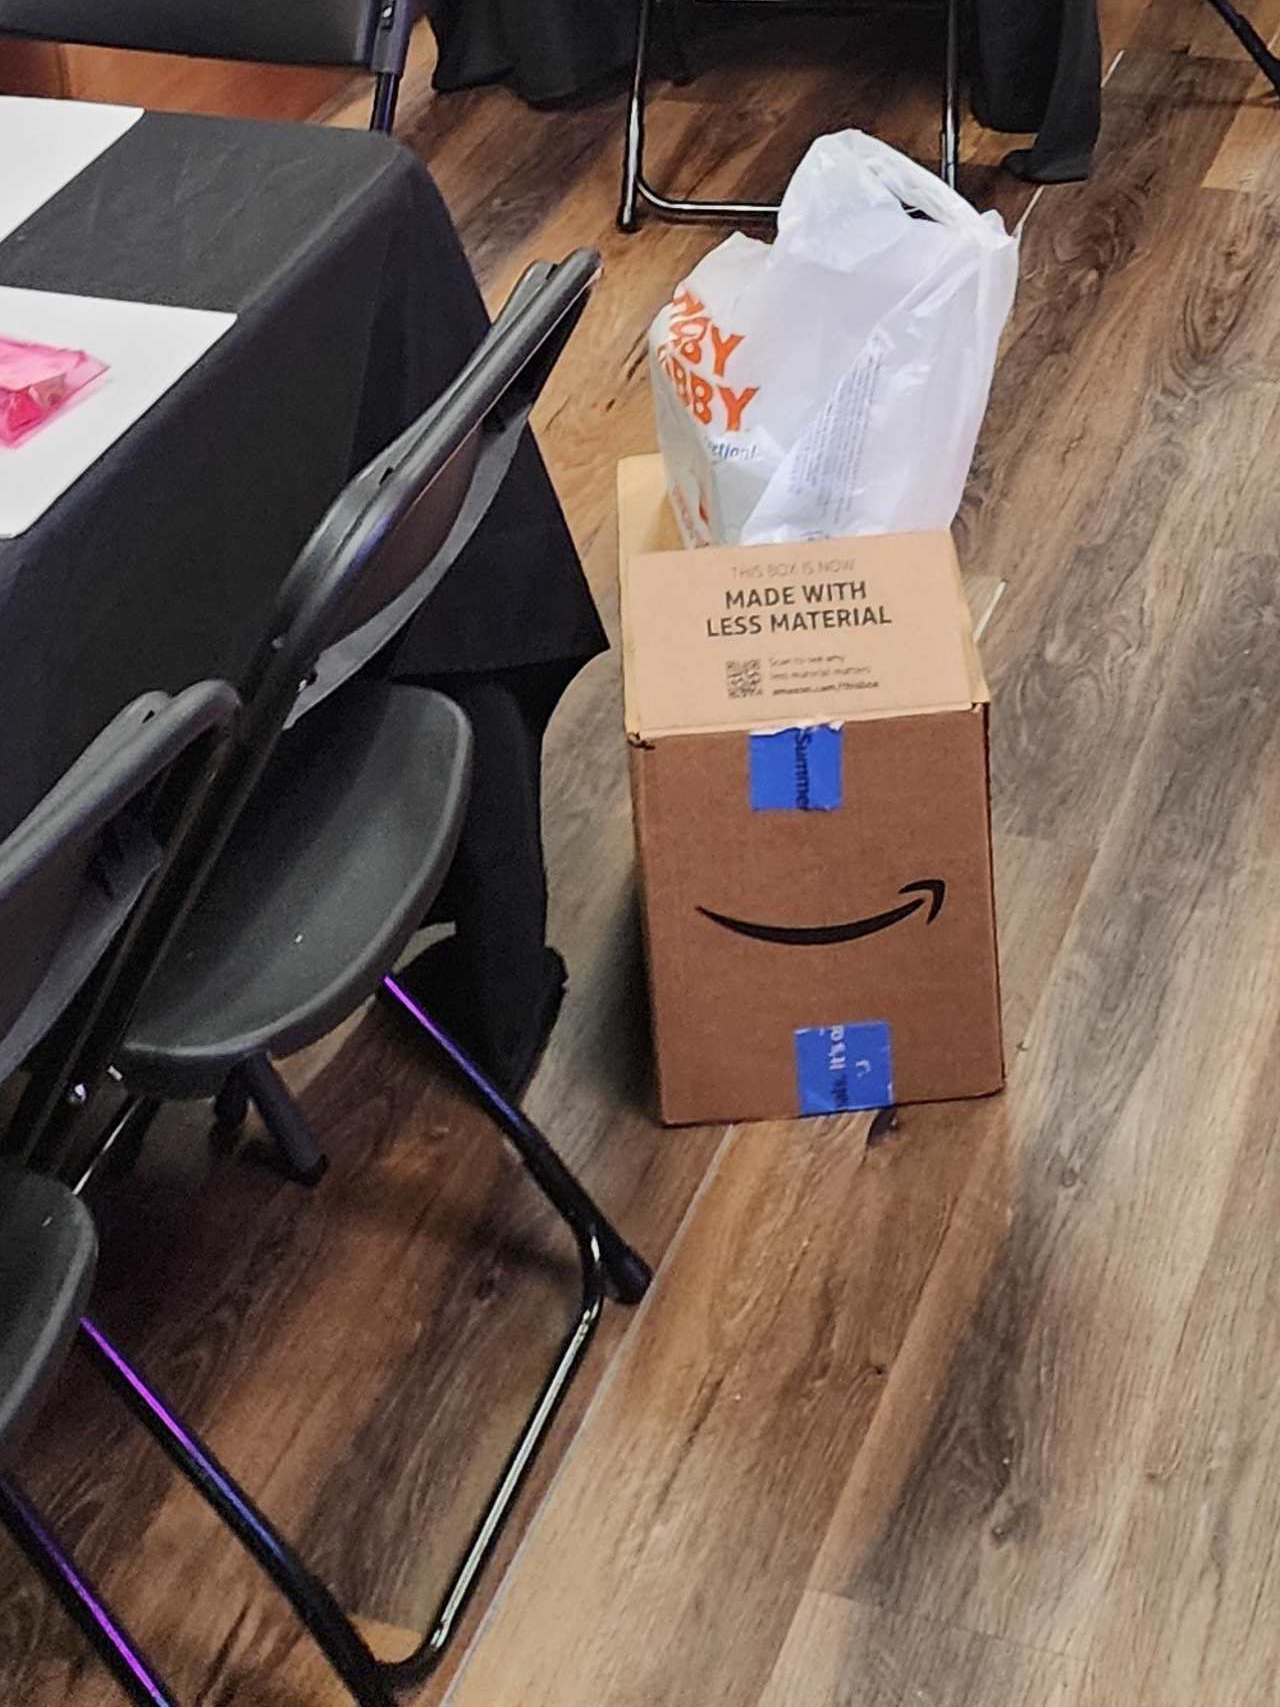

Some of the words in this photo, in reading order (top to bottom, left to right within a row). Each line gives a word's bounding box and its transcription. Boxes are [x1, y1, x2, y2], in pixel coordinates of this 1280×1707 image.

[725, 585, 795, 609] MADE
[802, 580, 867, 604] WITH
[706, 615, 762, 637] LESS
[770, 605, 892, 633] MATERIAL
